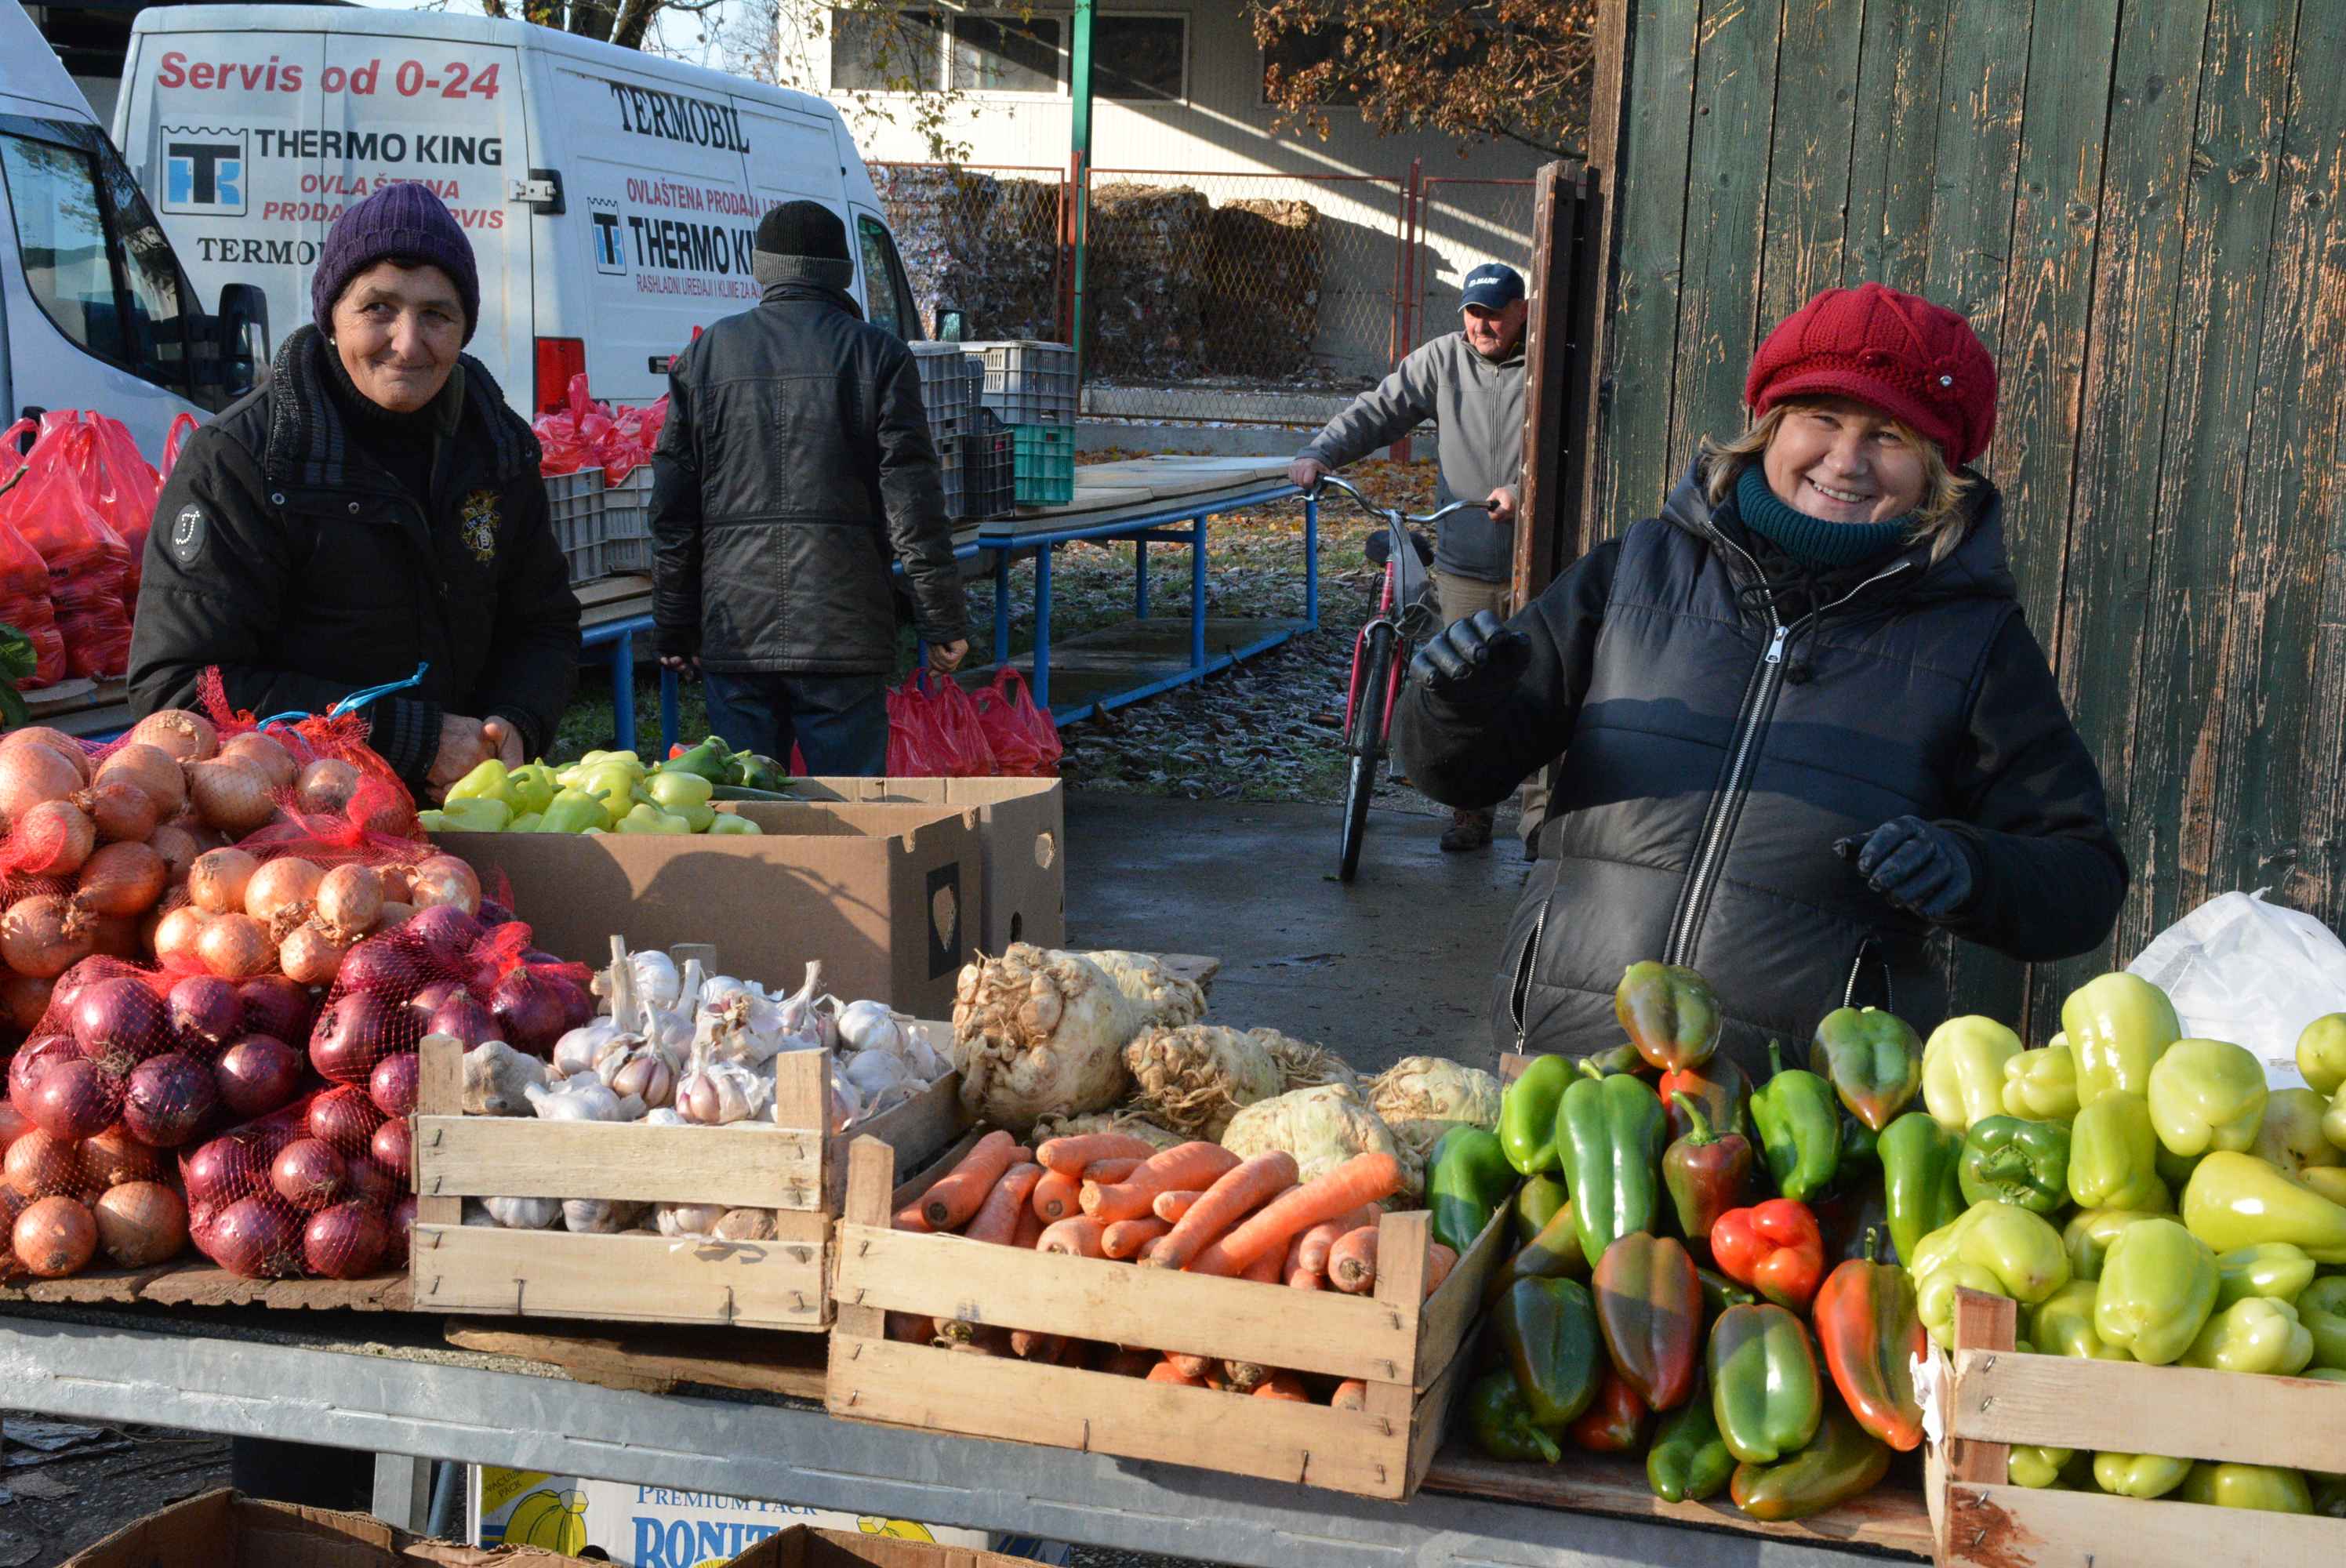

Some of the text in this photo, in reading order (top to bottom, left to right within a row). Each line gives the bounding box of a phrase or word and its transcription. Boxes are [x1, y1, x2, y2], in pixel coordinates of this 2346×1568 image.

[158, 52, 500, 100] Servis od 0-24
[610, 80, 750, 154] TERMOBIL
[255, 129, 502, 165] THERMO KING
[300, 172, 459, 199] OVLAŠNA
[627, 177, 704, 211] OVLAŠTENA
[706, 189, 761, 220] PRODAJA
[263, 201, 344, 222] PRODA
[197, 238, 324, 265] TERMO
[628, 216, 729, 274] THERMO
